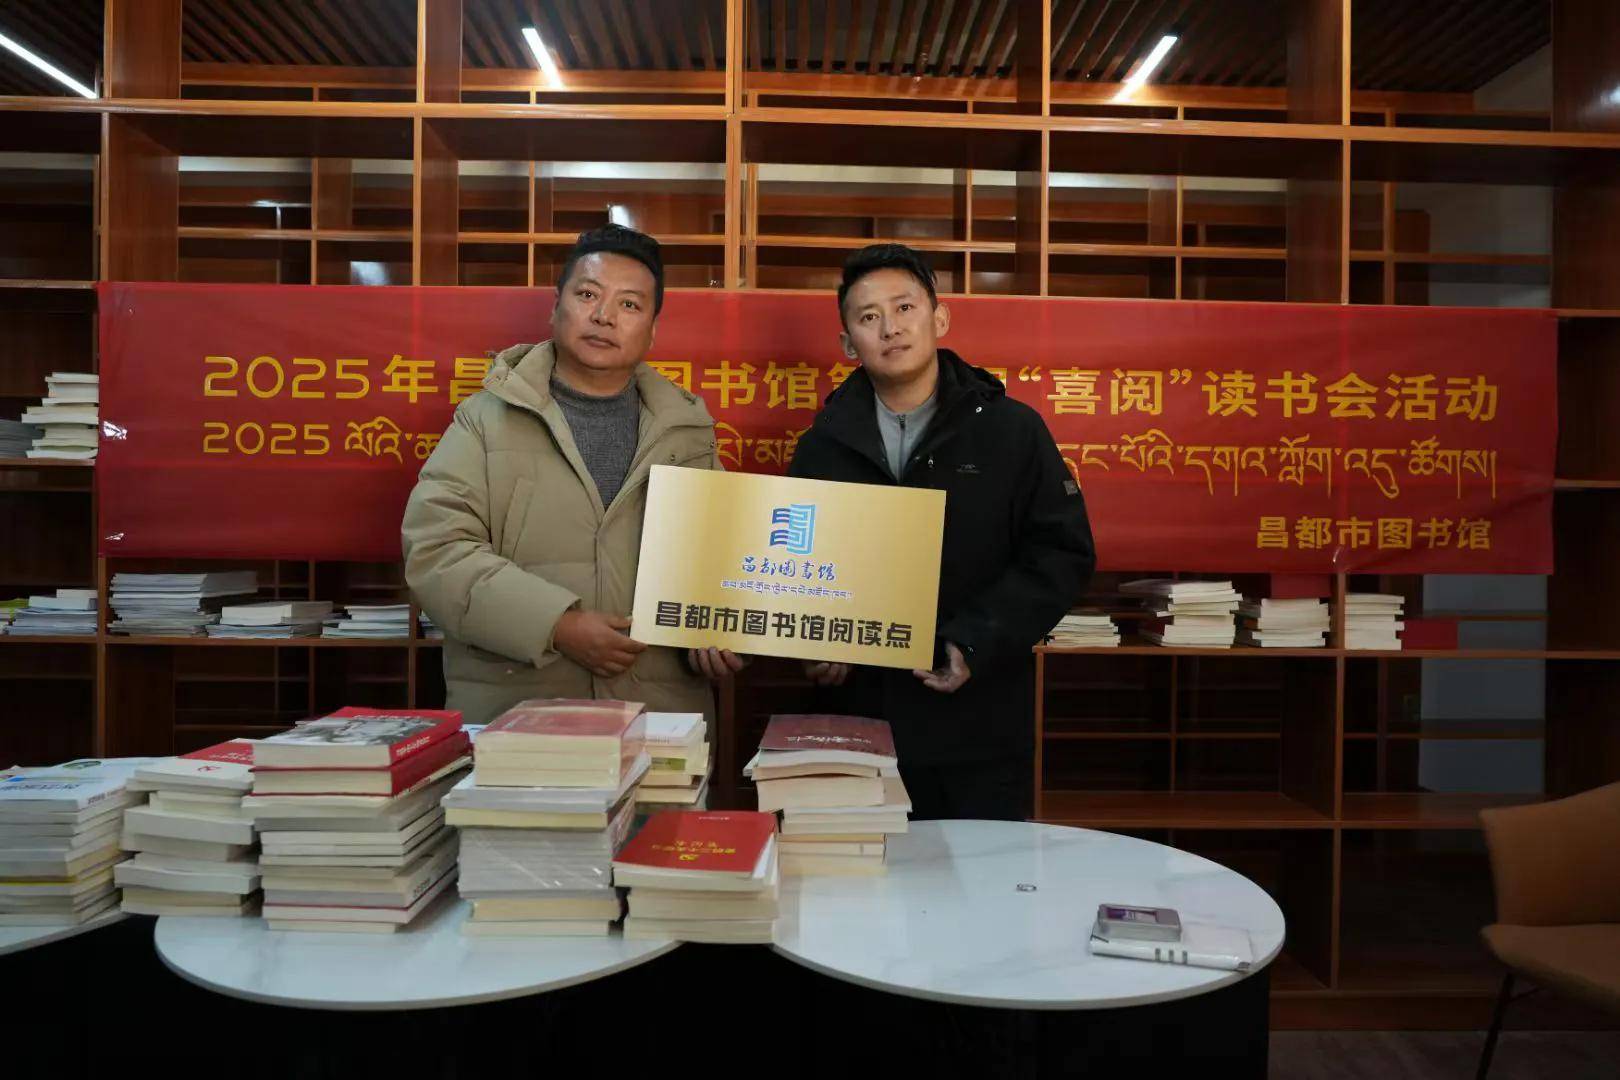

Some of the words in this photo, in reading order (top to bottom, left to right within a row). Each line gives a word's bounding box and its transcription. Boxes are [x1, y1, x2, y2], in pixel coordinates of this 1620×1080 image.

[984, 366, 1498, 422] “喜阅”读书会活动
[203, 422, 331, 455] 2025
[1256, 516, 1492, 549] 昌都市图书馆
[655, 601, 913, 648] 昌都市图书馆阅读点
